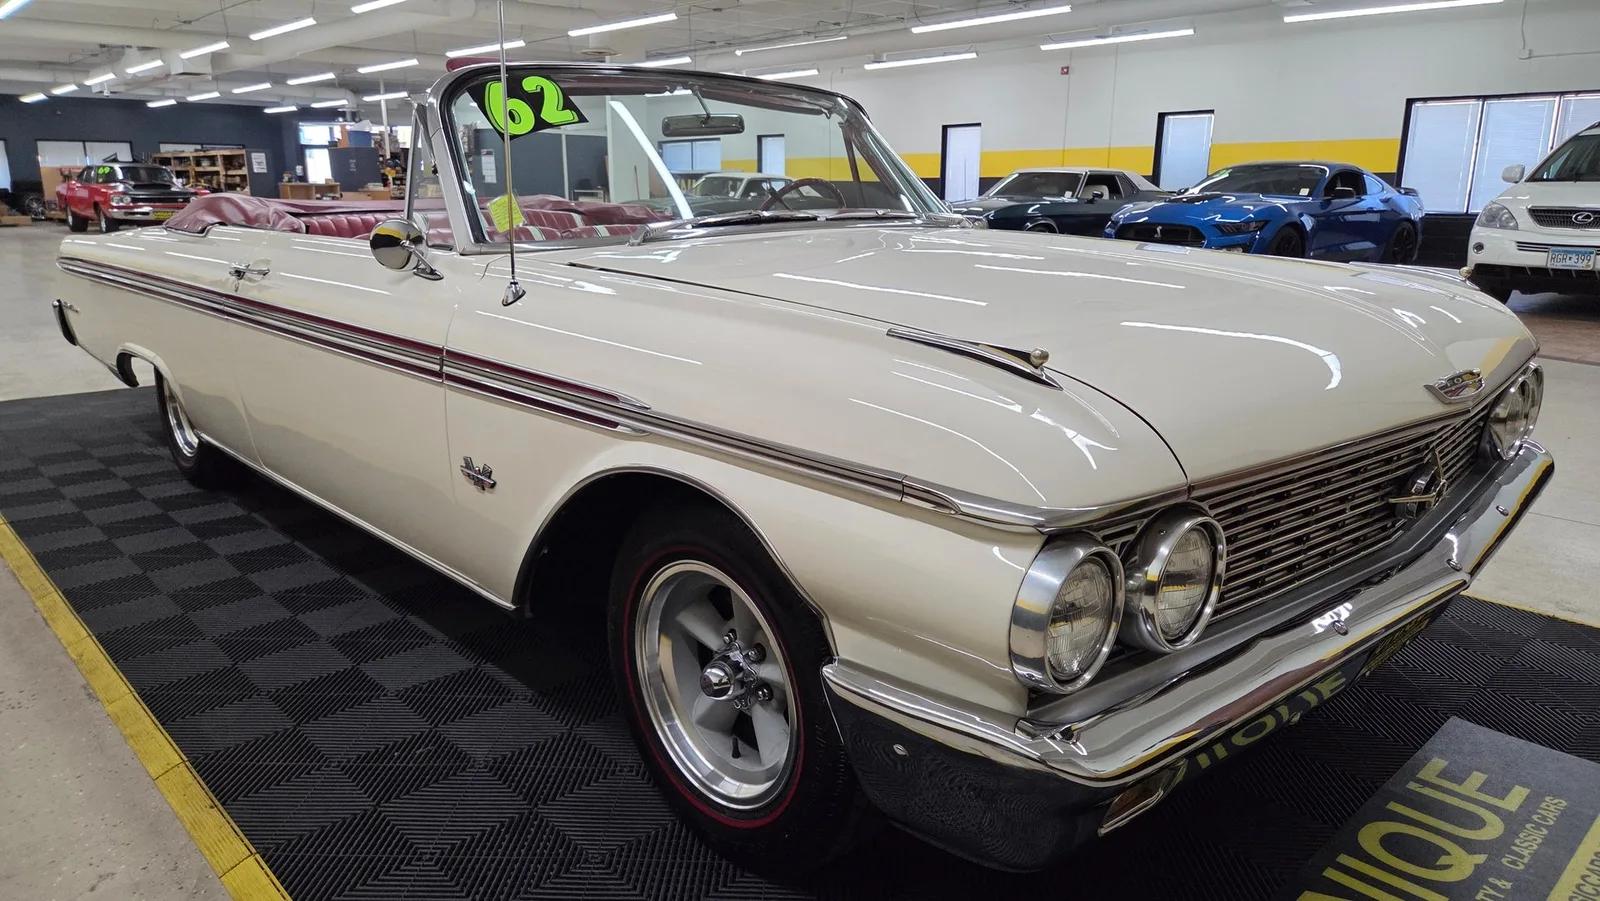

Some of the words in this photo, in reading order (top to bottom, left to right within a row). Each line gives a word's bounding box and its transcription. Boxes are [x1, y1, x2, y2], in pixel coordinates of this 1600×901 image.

[484, 76, 580, 136] 62
[1501, 823, 1549, 870] CLASSIC
[1532, 796, 1568, 826] CARS
